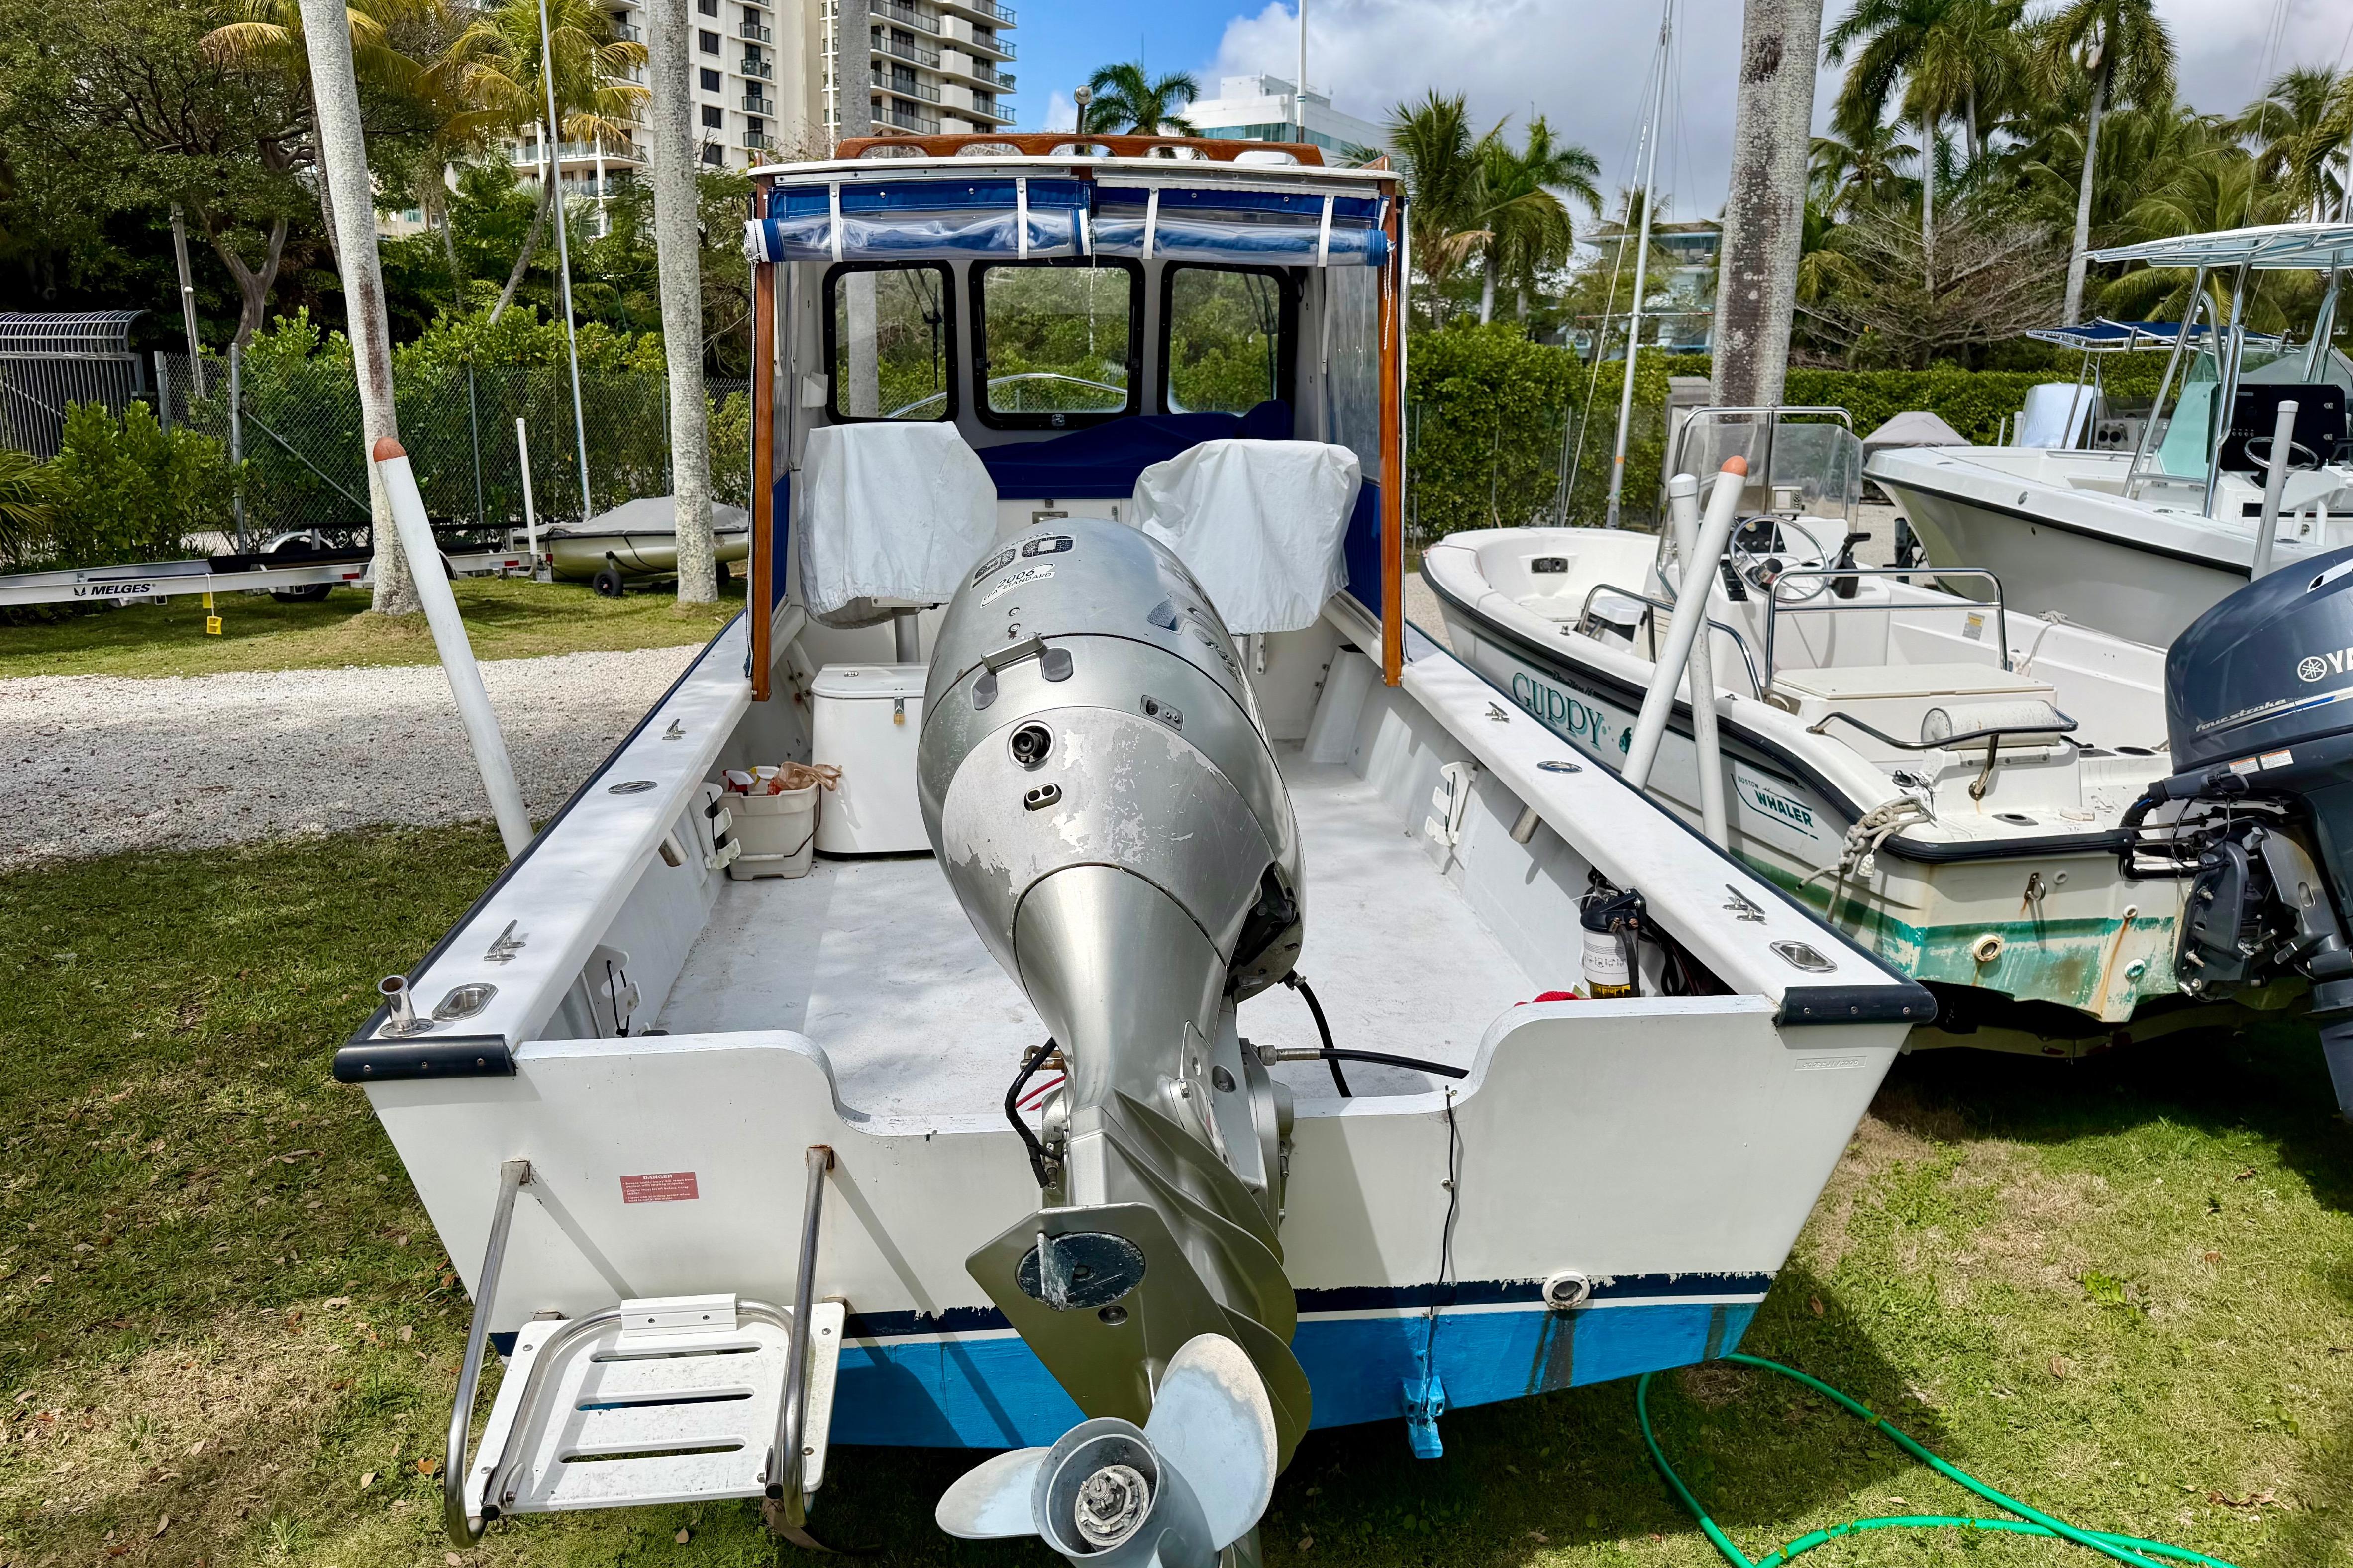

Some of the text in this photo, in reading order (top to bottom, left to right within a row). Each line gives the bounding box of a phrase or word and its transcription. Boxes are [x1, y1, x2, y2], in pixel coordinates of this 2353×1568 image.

[997, 569, 1035, 588] 2006
[1003, 573, 1052, 590] STANDARD
[91, 584, 151, 595] MELGES
[1738, 776, 1759, 789] BOSTON
[1754, 789, 1814, 828] WHALER
